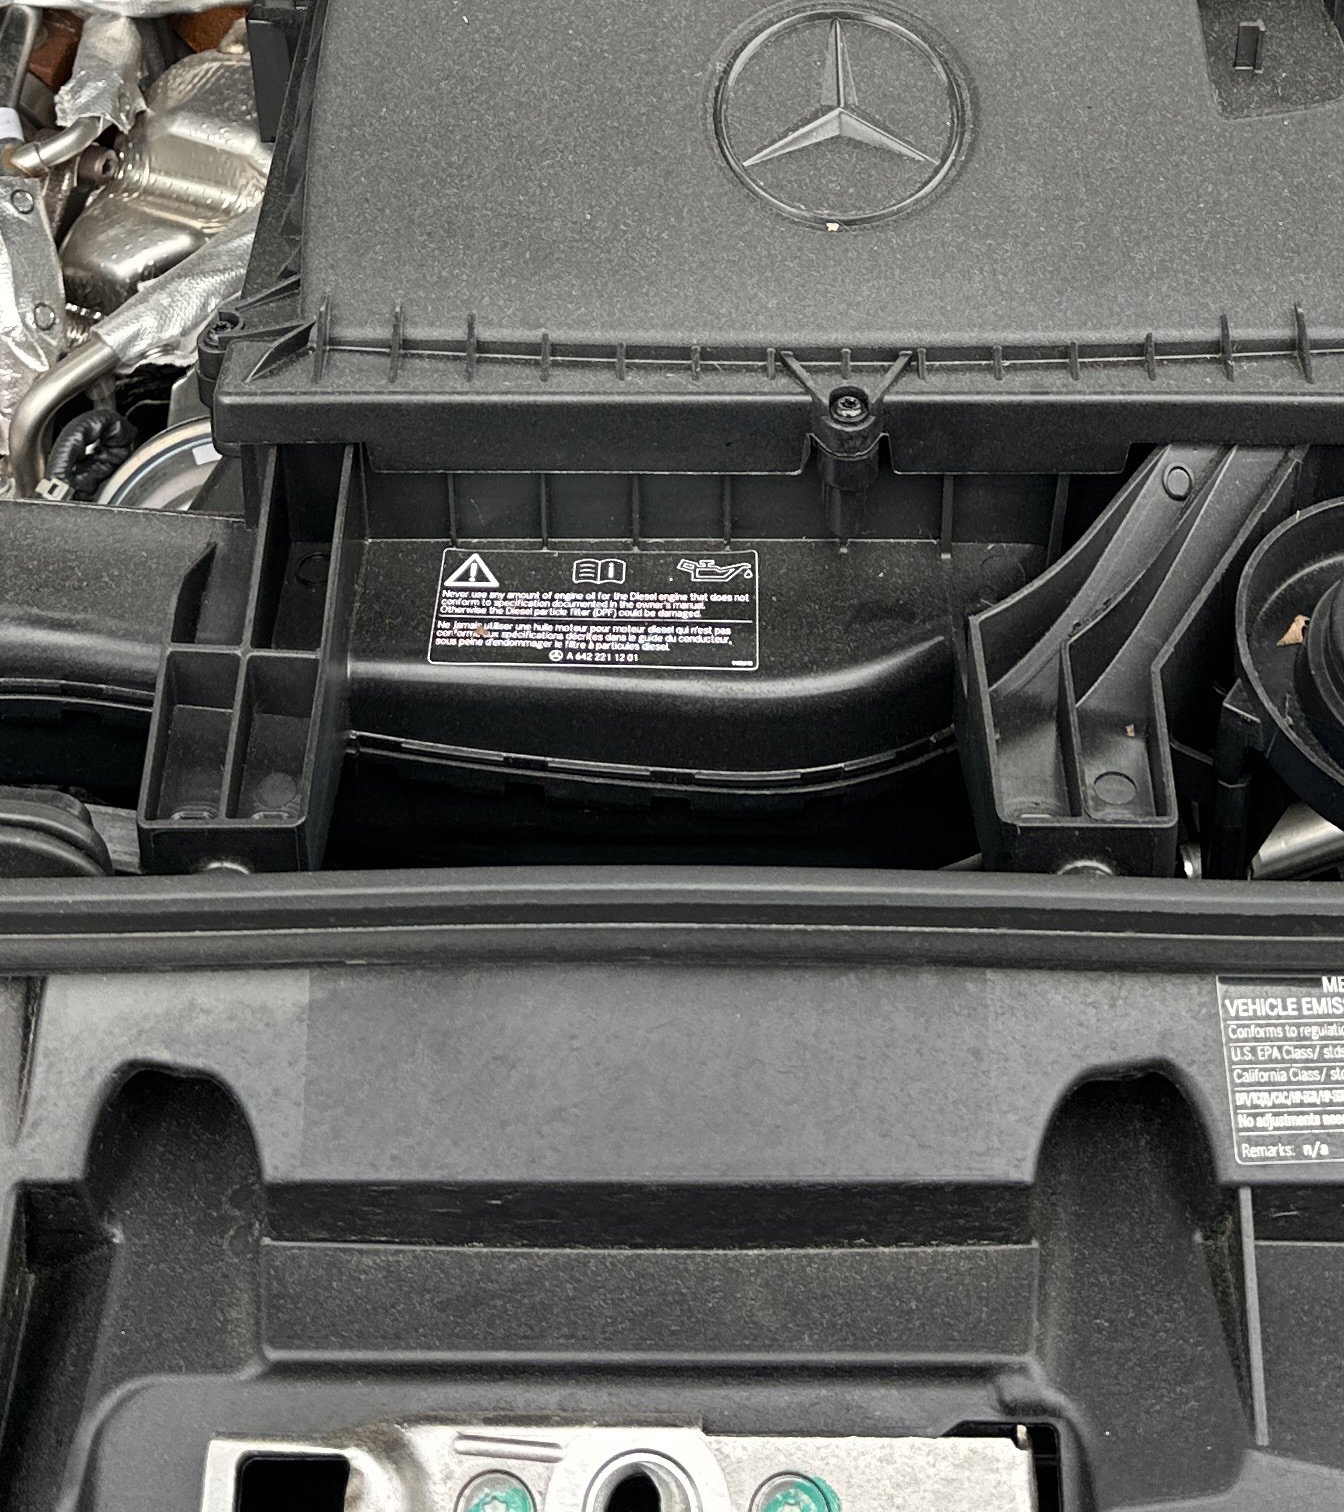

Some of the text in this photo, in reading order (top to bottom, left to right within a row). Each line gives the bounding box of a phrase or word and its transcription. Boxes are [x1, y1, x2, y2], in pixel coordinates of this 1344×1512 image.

[441, 589, 469, 599] Never
[470, 591, 487, 600] use
[488, 591, 505, 600] any
[506, 591, 540, 600] amount
[541, 591, 552, 599] of
[553, 591, 584, 601] engine
[597, 591, 610, 600] for
[613, 591, 628, 602] the
[629, 591, 657, 600] Diesel
[657, 592, 688, 602] engine
[689, 592, 708, 603] that
[709, 592, 733, 601] does
[733, 593, 749, 602] not
[566, 651, 573, 660] A
[594, 652, 611, 661] 221
[614, 653, 625, 661] 12
[626, 653, 638, 661] 01
[1224, 997, 1298, 1016] VEHICLE
[1226, 1021, 1283, 1039] Conforms
[1283, 1021, 1298, 1037] to
[1230, 1046, 1255, 1061] U.S.
[1256, 1045, 1281, 1060] EPA
[1282, 1044, 1320, 1059] Class/
[1231, 1066, 1287, 1083] California
[1288, 1065, 1326, 1082] Class/
[1236, 1113, 1254, 1128] No
[1255, 1112, 1321, 1130] adjustments
[1241, 1141, 1329, 1158] Remarks: n/a
